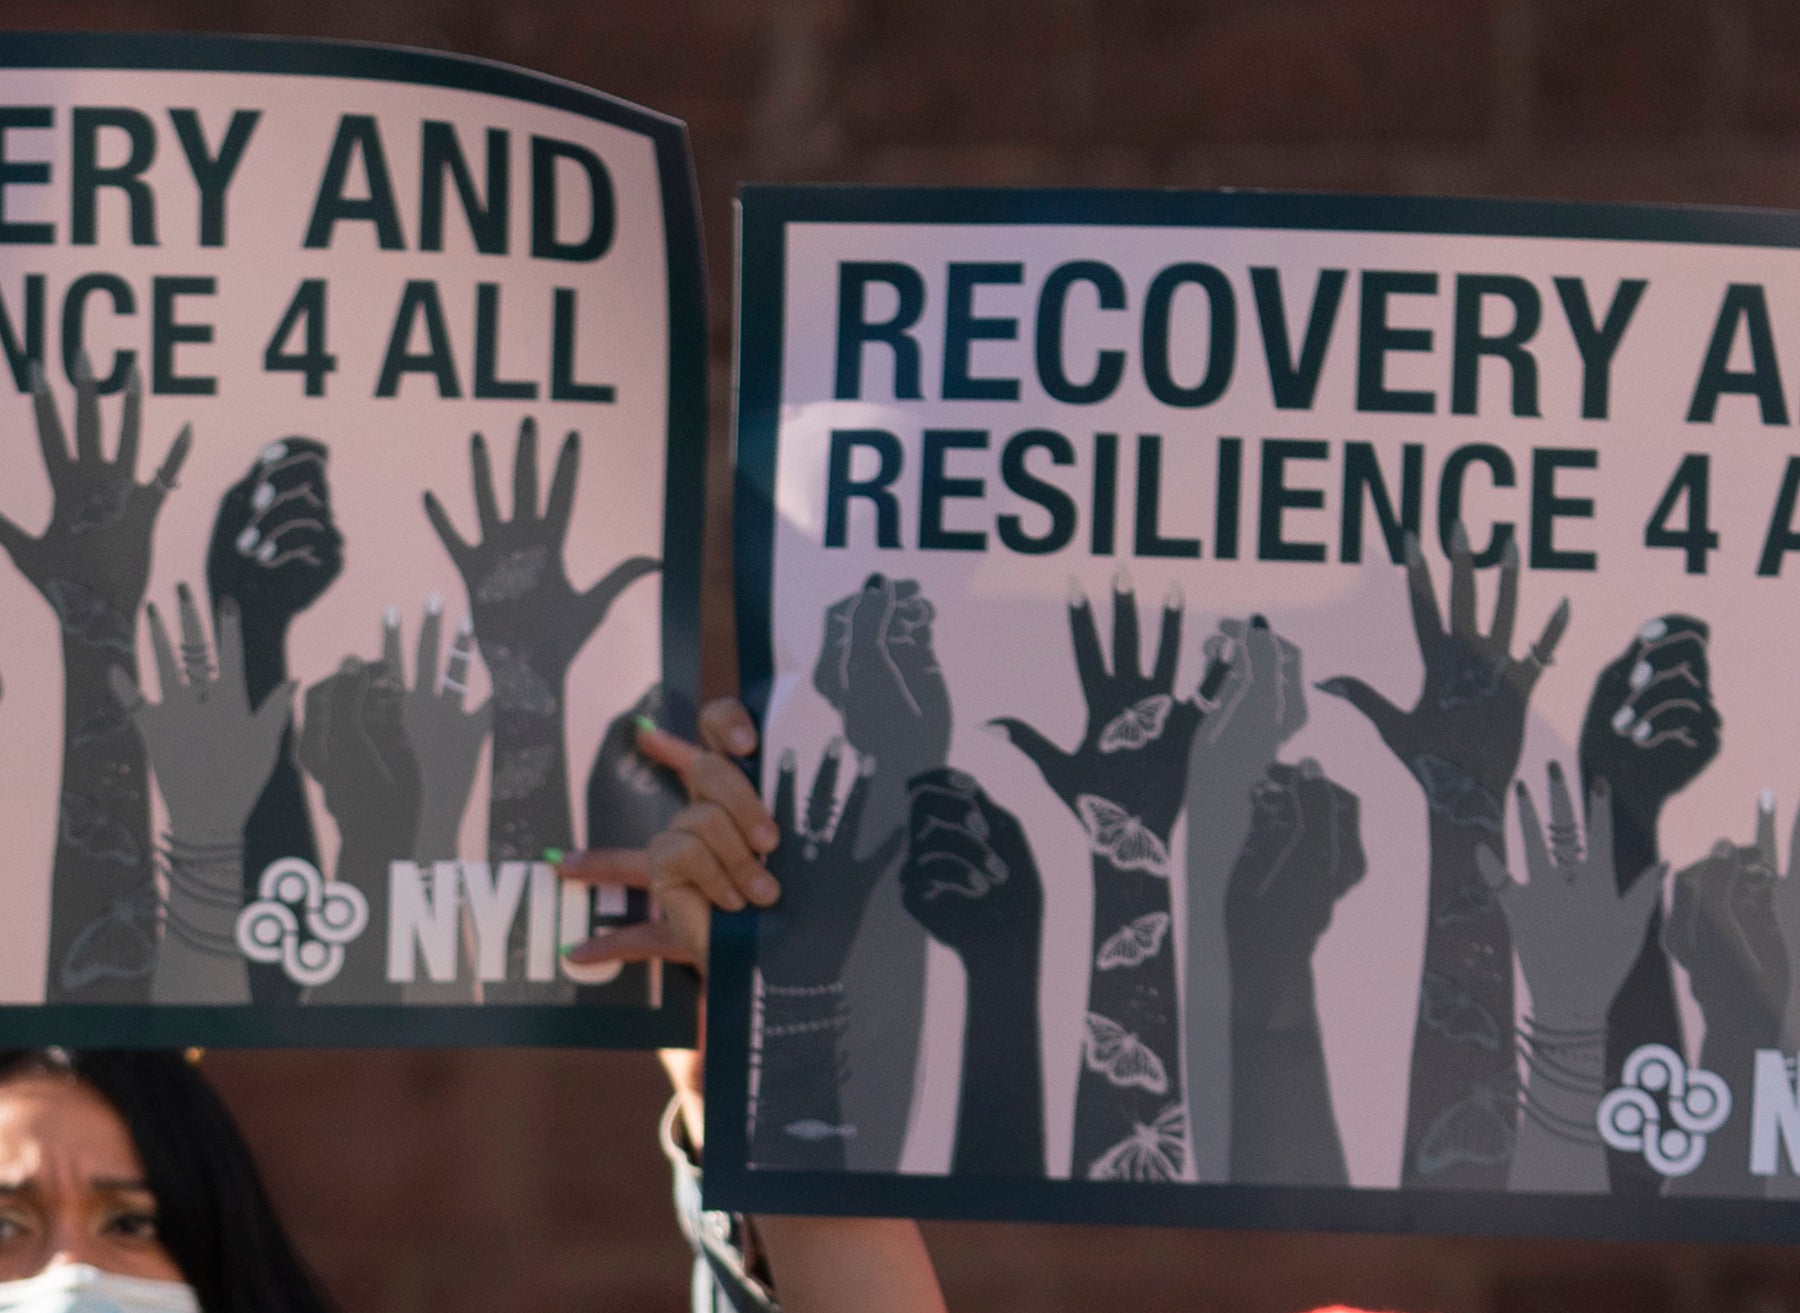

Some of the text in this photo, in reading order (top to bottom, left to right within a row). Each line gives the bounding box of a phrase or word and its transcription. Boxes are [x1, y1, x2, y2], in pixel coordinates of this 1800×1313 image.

[304, 113, 617, 264] AND
[263, 278, 337, 397] 4
[374, 280, 617, 404] ALL
[833, 259, 1649, 421] RECOVERY
[822, 428, 1598, 571] RESILIENCE
[1643, 454, 1720, 576] 4
